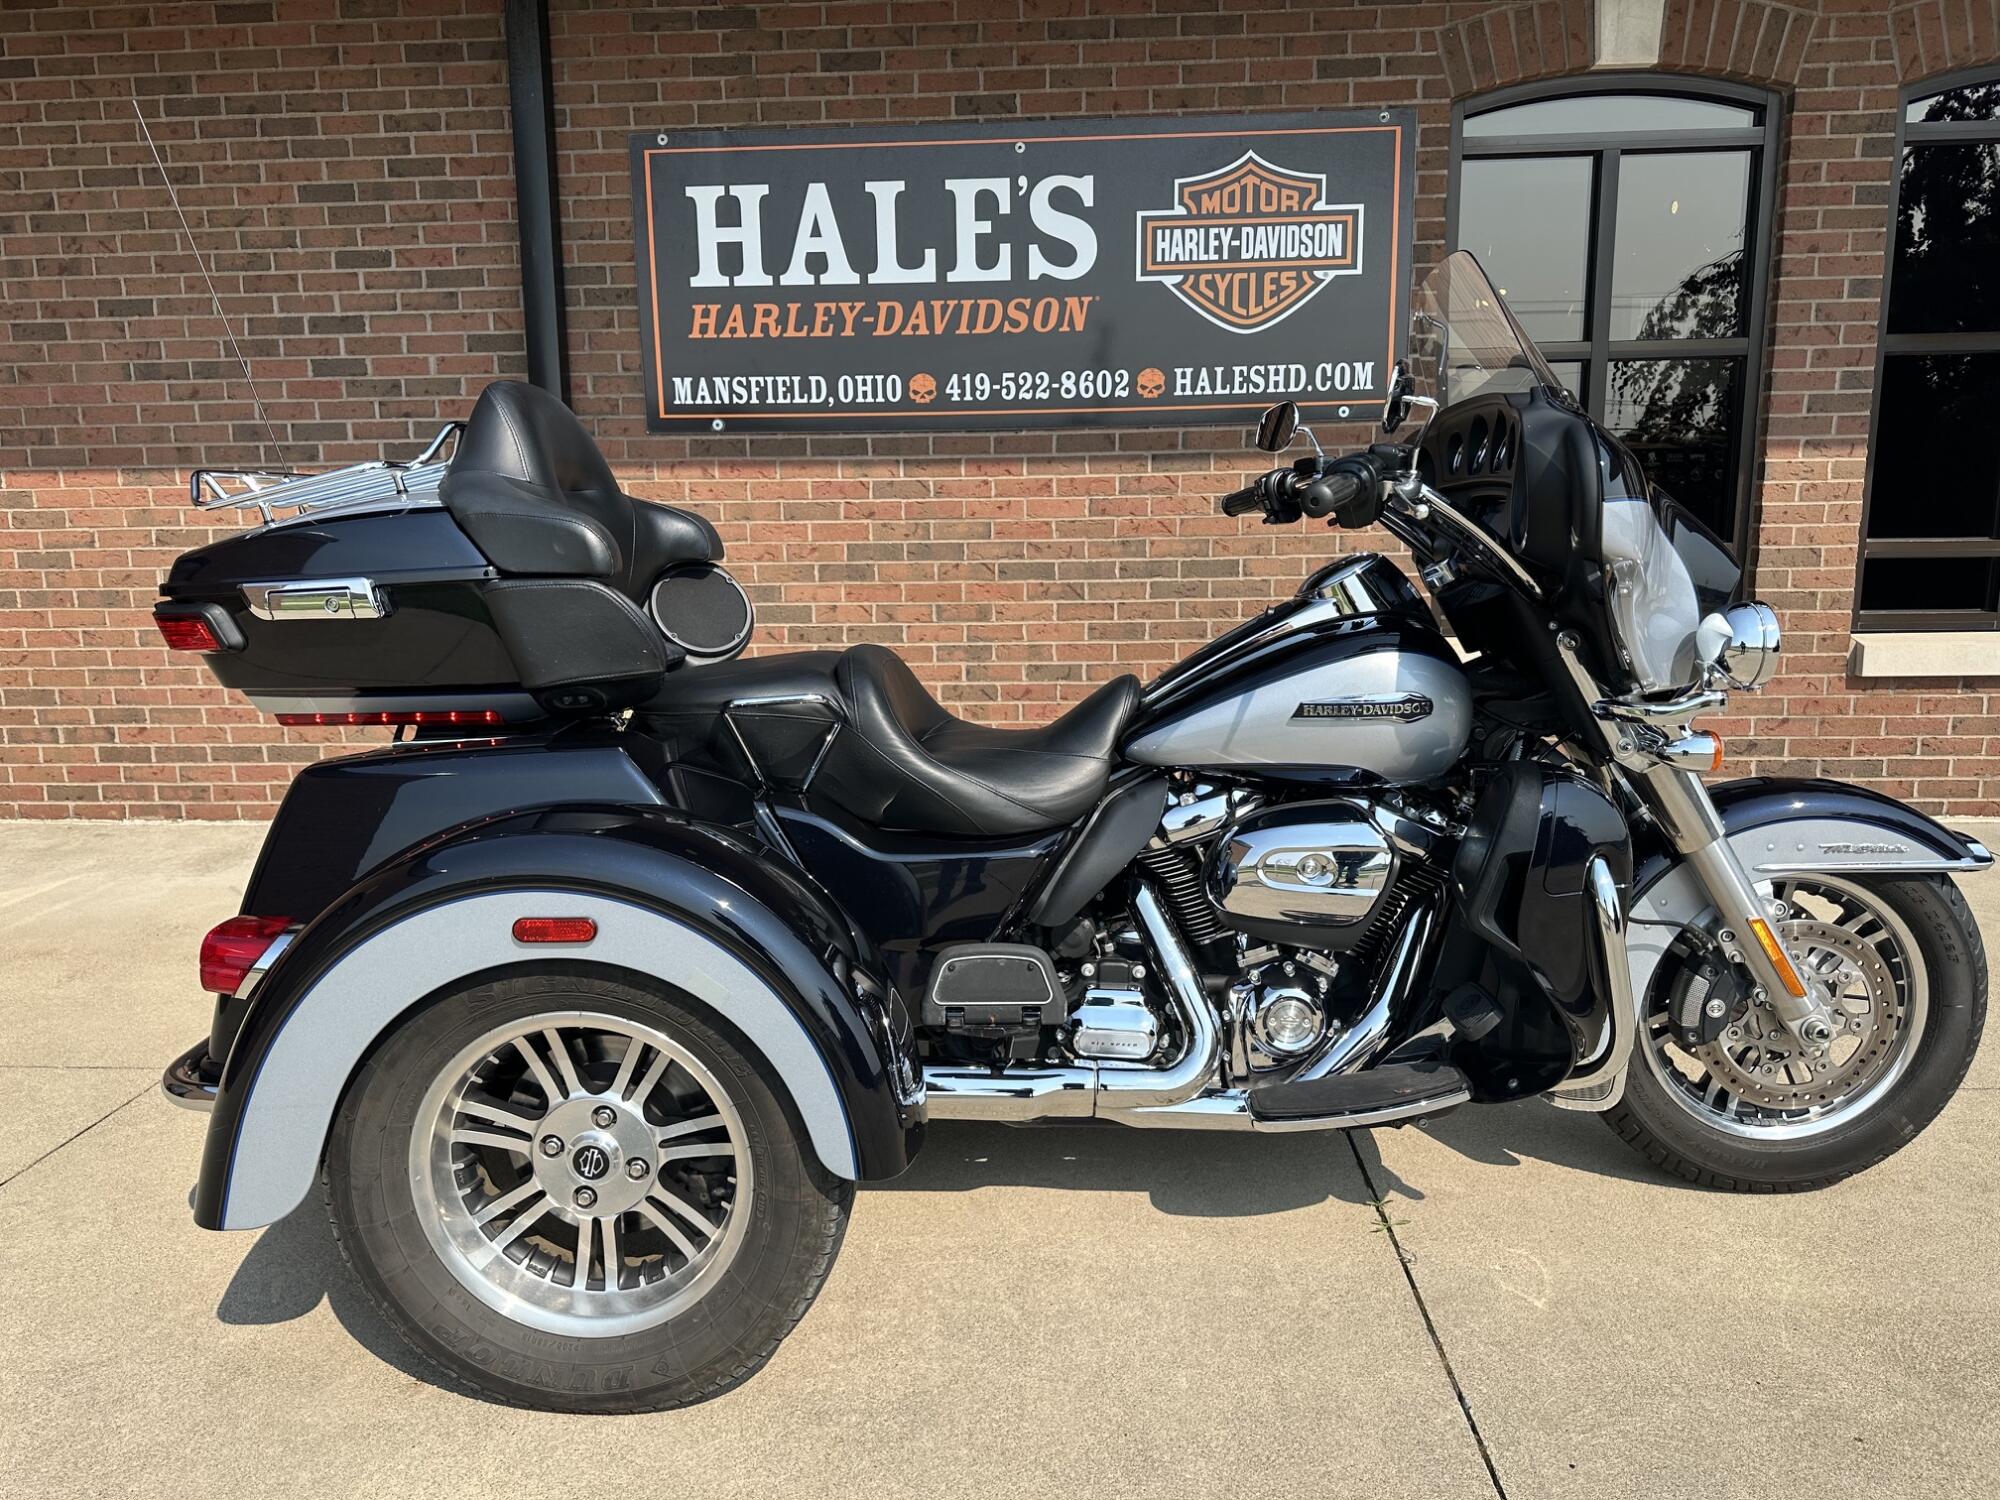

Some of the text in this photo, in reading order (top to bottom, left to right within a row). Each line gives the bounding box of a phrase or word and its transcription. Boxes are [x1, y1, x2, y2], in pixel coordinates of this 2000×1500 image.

[1201, 174, 1300, 215] MOTOR
[685, 174, 1099, 288] HALE'S
[1156, 223, 1343, 263] HARLEY-DAVIDSON
[1199, 270, 1297, 317] CYCLES
[688, 296, 1092, 339] HARLEY-DAVIDSON
[945, 369, 1130, 402] 419-522-8602
[1173, 361, 1375, 396] HALESHD.COM
